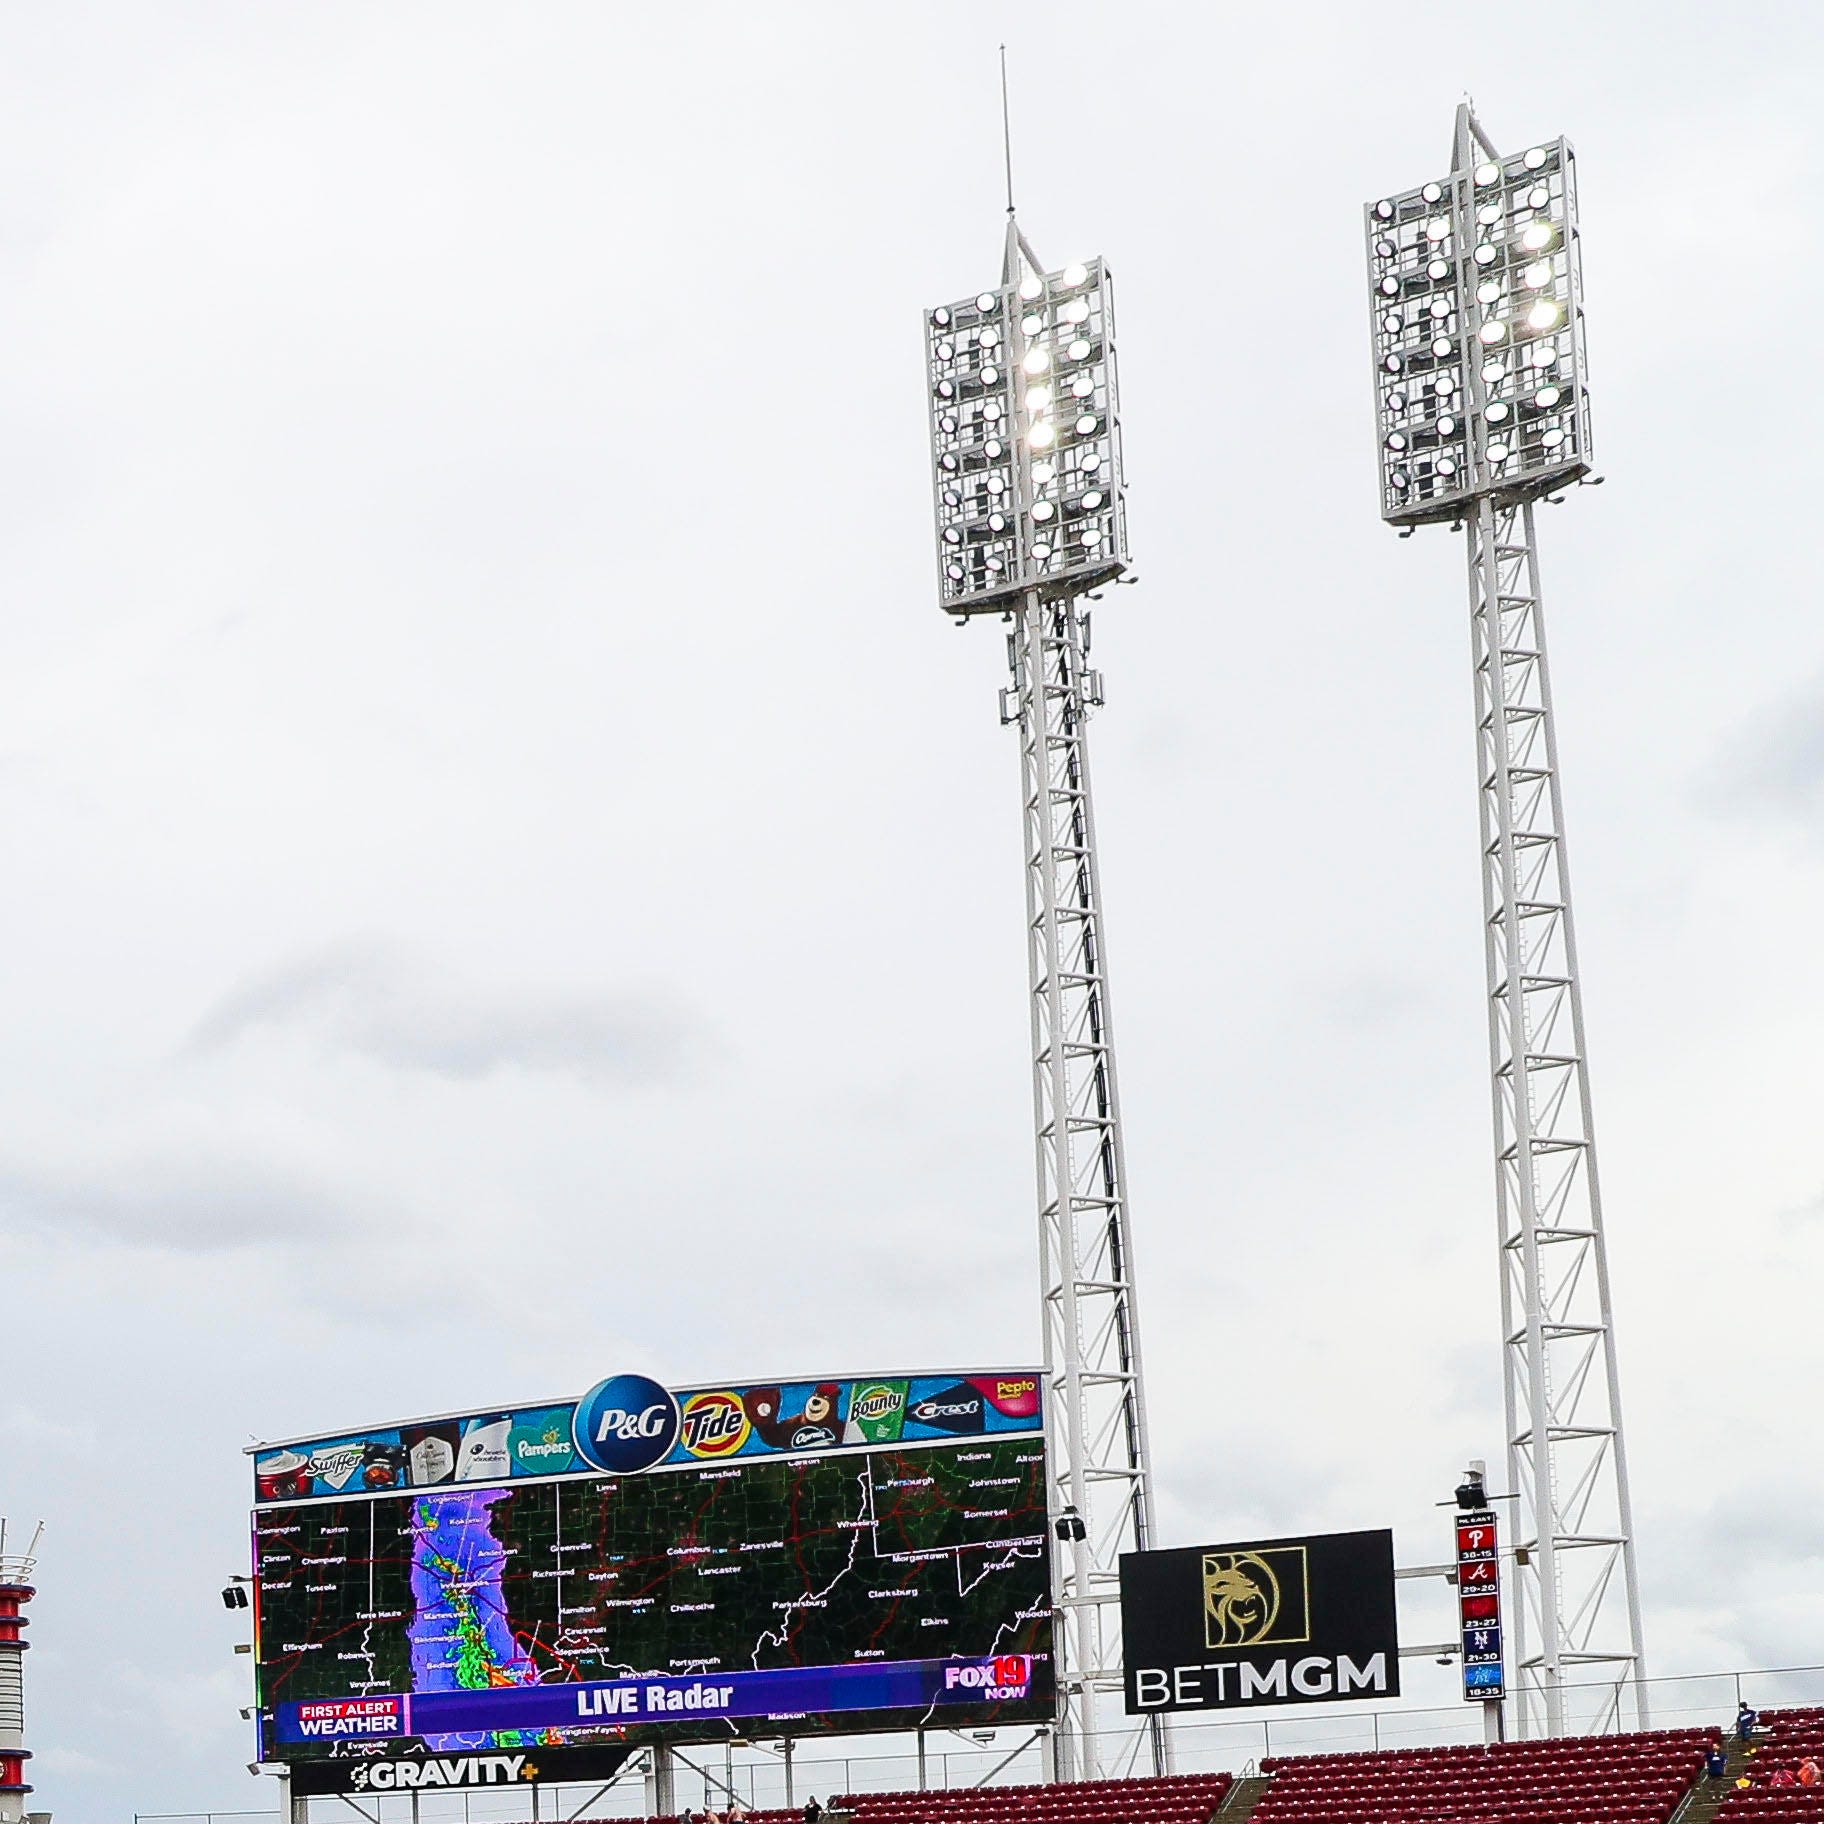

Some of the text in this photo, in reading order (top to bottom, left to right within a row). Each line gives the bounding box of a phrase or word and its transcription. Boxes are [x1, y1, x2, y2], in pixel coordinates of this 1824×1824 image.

[997, 1381, 1034, 1392] Pepto
[914, 1400, 979, 1419] Crest
[598, 1404, 668, 1442] P&G
[306, 1446, 364, 1477] Swiffer
[518, 1439, 571, 1459] Pampers
[946, 1656, 1027, 1689] FOX19
[1136, 1653, 1387, 1707] BETMGM
[578, 1684, 733, 1715] LIVE Radar
[985, 1686, 1026, 1700] NOW
[301, 1701, 393, 1718] FIRST ALERT
[299, 1716, 397, 1736] WEATHER
[368, 1756, 527, 1787] GRAVITY
